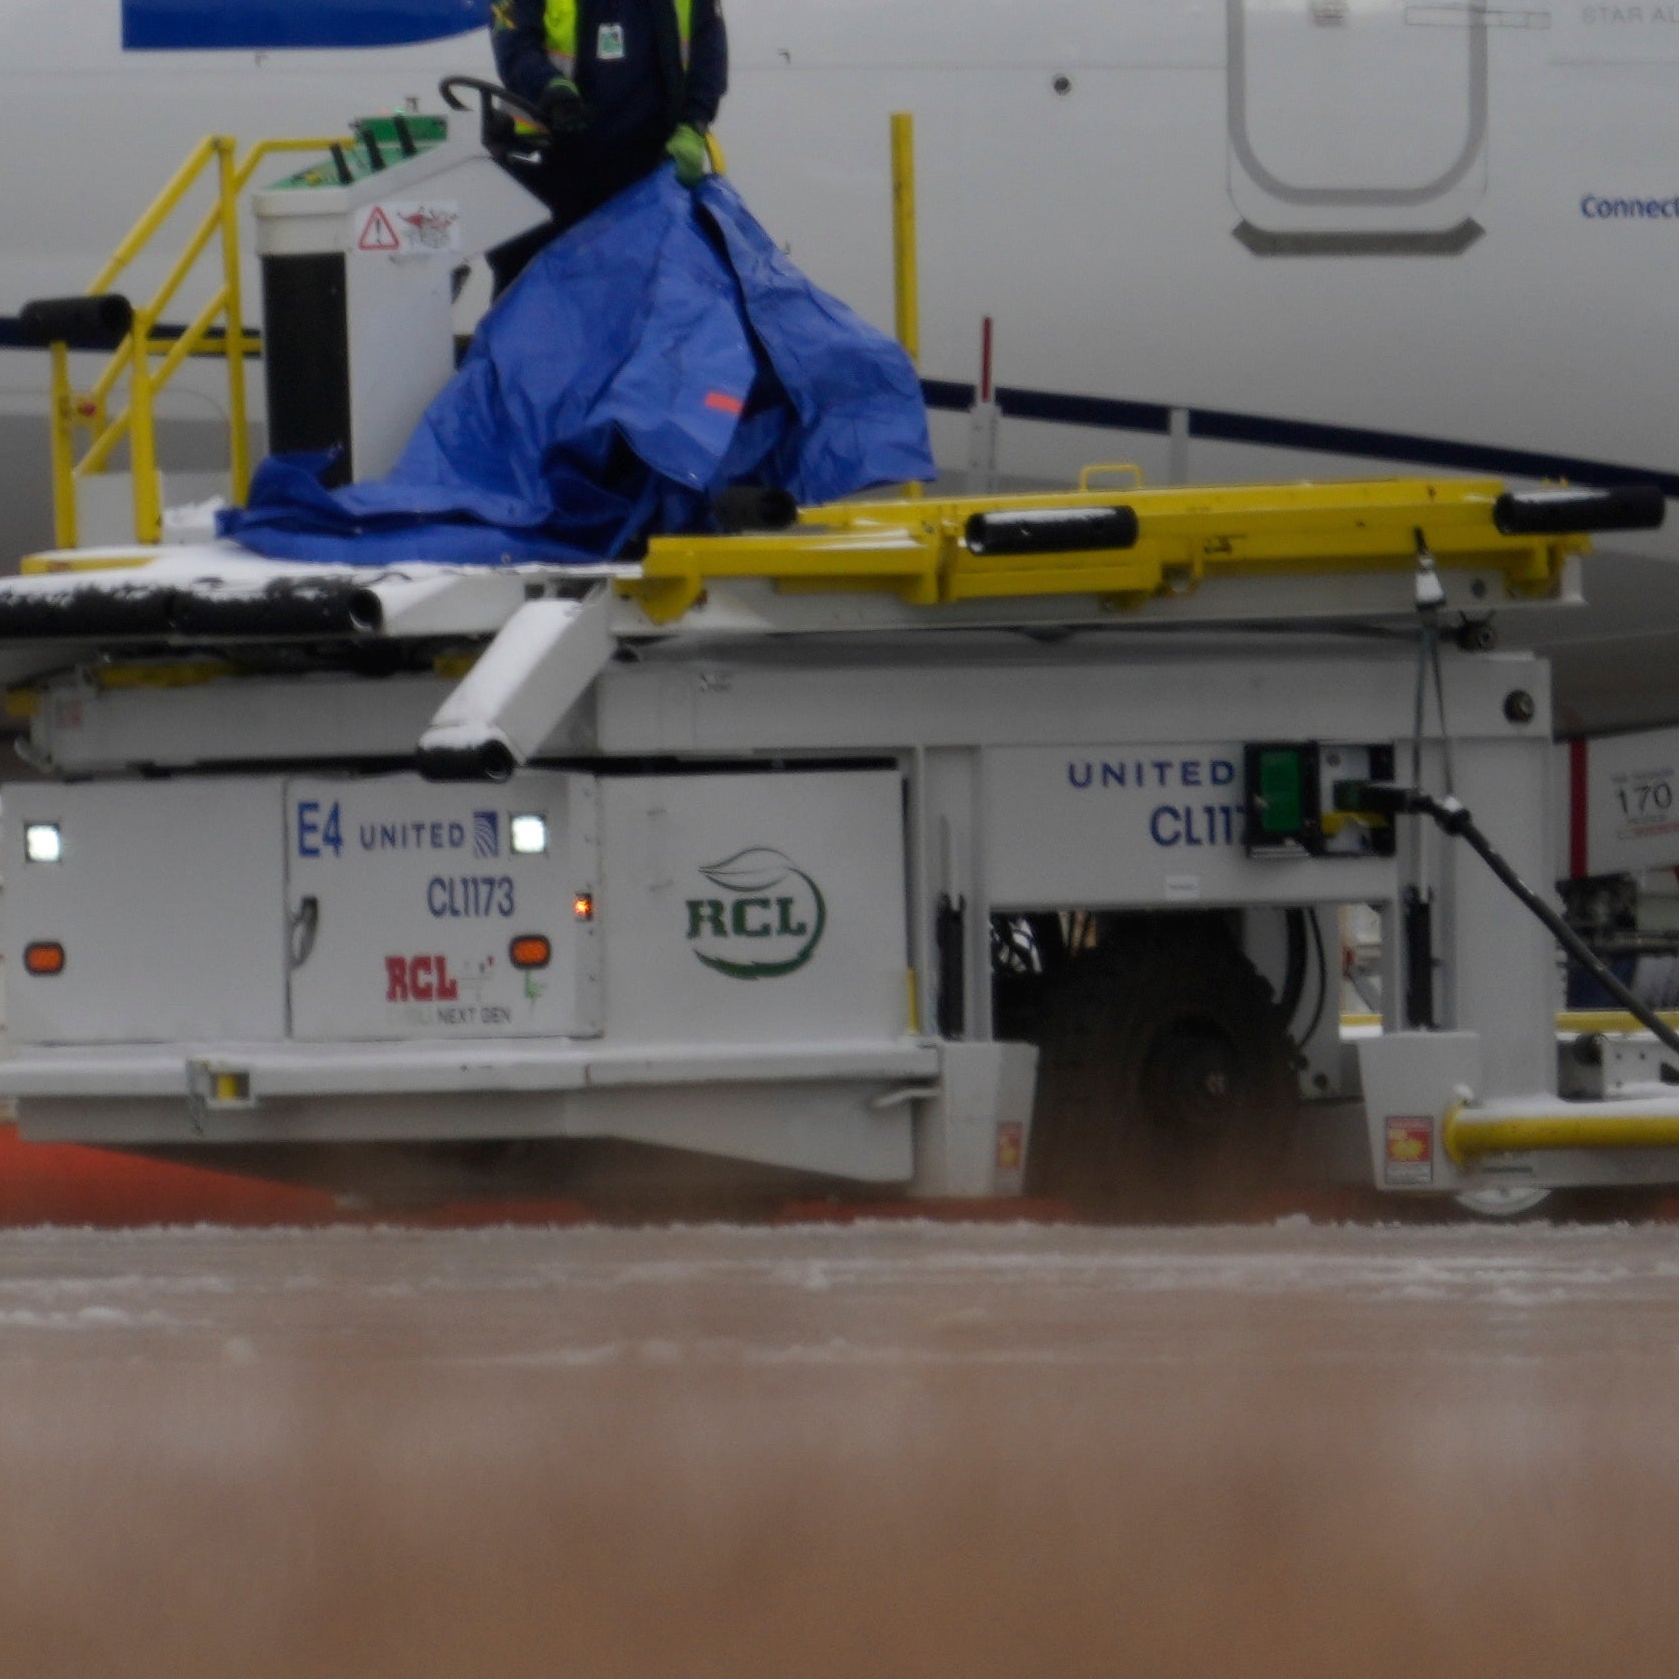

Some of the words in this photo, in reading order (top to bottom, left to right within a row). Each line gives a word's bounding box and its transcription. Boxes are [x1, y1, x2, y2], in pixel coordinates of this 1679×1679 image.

[1068, 759, 1235, 788] UNITED
[1617, 781, 1672, 814] 170
[297, 801, 343, 857] E4
[359, 821, 465, 850] UNITED
[427, 877, 515, 918] CL1173
[685, 896, 807, 940] RCL
[385, 955, 458, 1003] RCL
